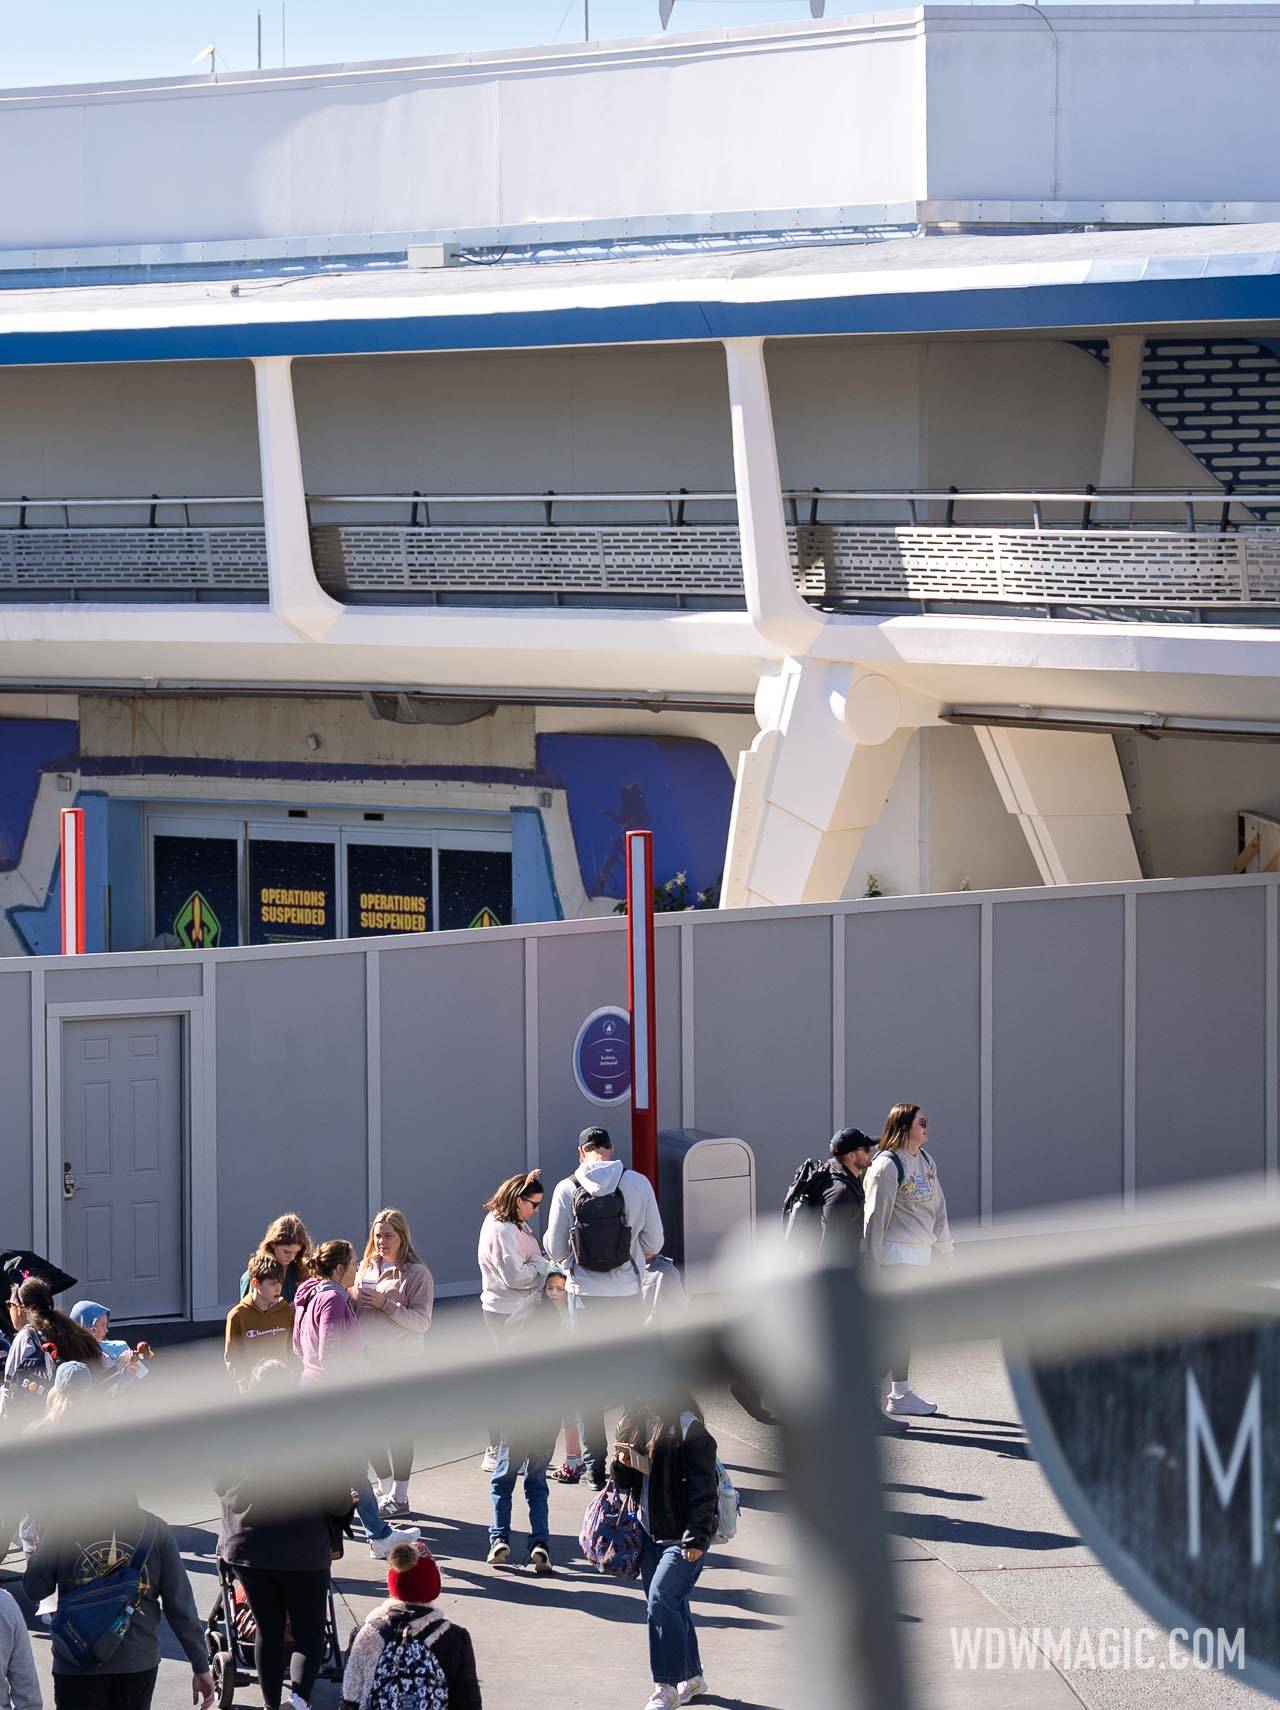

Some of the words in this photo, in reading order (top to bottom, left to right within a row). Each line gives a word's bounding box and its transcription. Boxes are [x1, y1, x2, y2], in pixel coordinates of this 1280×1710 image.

[261, 888, 325, 907] OPERATIONS
[360, 893, 425, 912] OPERATIONS
[261, 906, 325, 926] SUSPENDED
[360, 911, 425, 931] SUSPENDED
[246, 1326, 287, 1338] Champion
[1185, 1366, 1264, 1567] M
